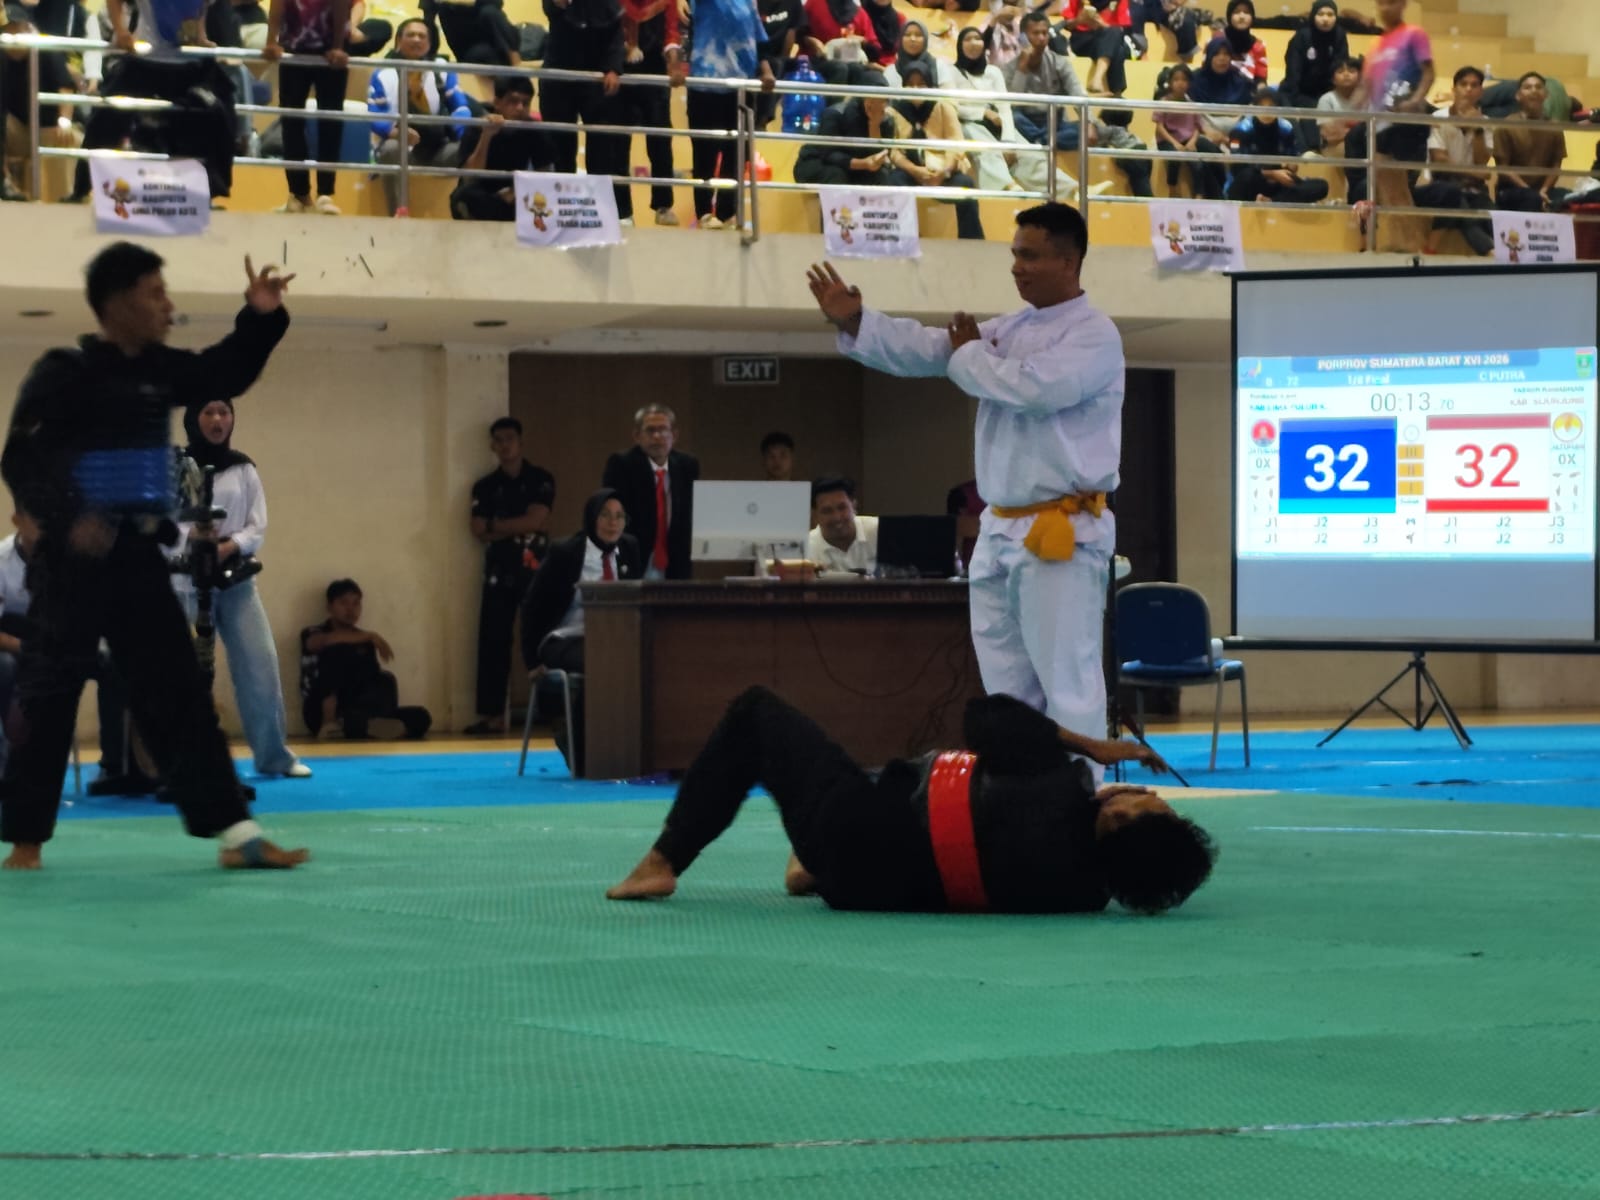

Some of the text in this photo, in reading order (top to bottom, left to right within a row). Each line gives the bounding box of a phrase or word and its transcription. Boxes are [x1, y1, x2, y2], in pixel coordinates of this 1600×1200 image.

[727, 361, 774, 379] EXIT
[1317, 358, 1368, 370] PORPROV
[1369, 356, 1425, 369] SUMATERA
[1427, 355, 1461, 367] BARAT
[1463, 355, 1481, 366] XVI
[1370, 391, 1431, 412] 00:13
[1304, 443, 1371, 492] 32
[1454, 443, 1521, 488] 32
